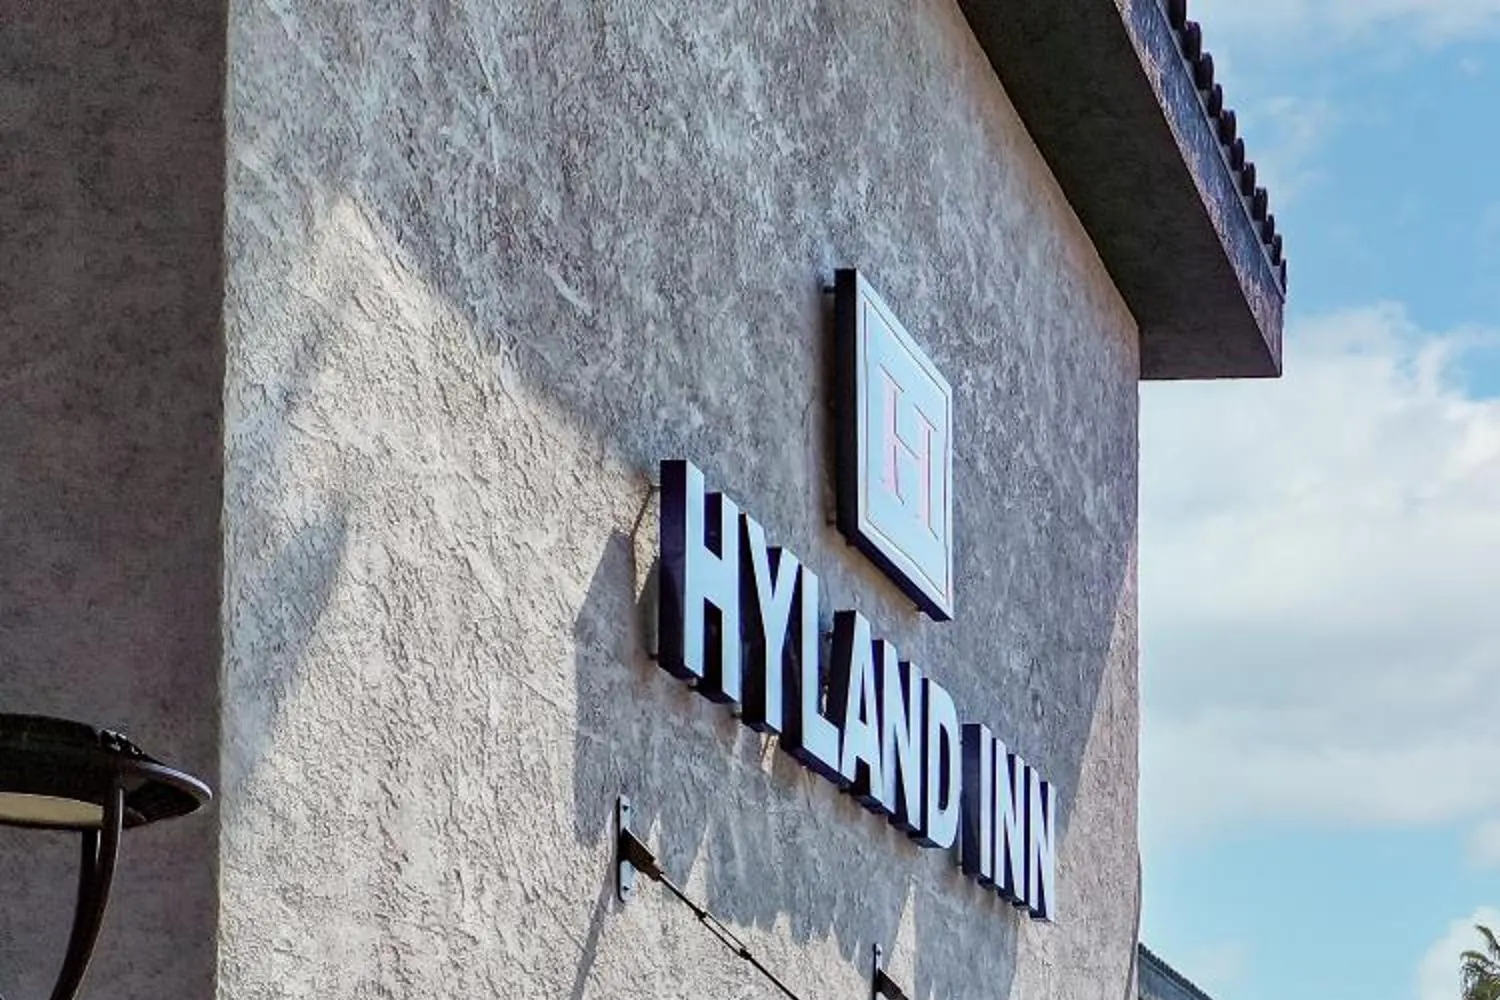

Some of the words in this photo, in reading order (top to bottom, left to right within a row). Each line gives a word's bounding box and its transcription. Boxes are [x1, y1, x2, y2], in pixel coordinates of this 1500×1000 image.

[880, 362, 939, 542] H
[663, 459, 963, 848] HYLAND
[968, 724, 1055, 922] INN
